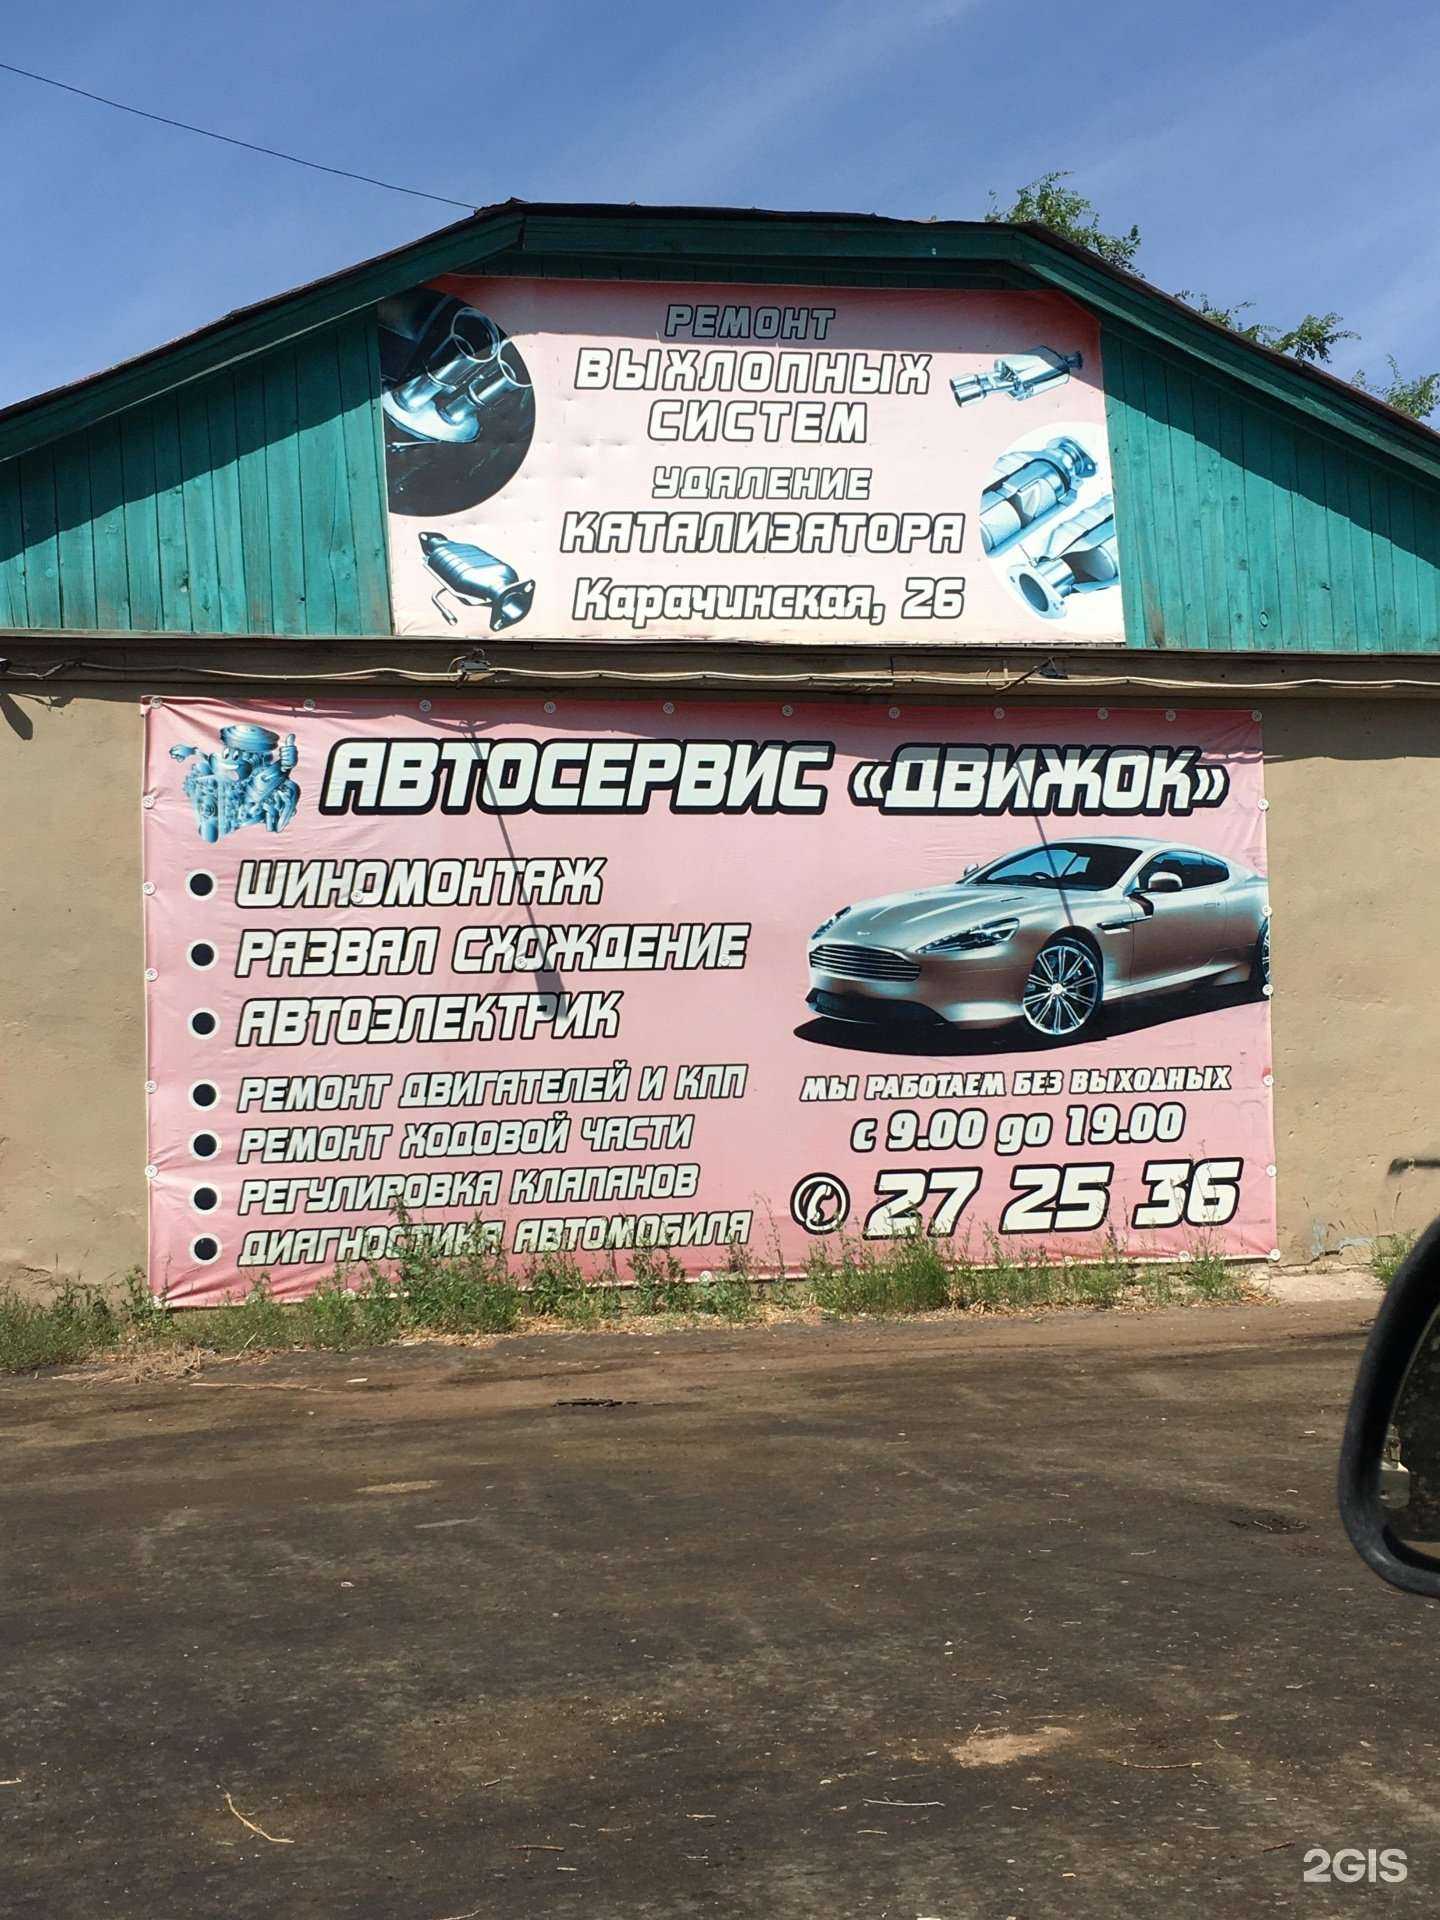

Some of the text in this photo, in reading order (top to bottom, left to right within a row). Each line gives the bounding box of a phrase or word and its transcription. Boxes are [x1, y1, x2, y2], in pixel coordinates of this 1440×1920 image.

[665, 304, 835, 339] РЕМОНТ
[573, 347, 932, 395] ВЫХЛОПНЫХ
[647, 400, 869, 443] СИСТЕМ
[652, 466, 871, 501] УДАЛЕНИЕ
[560, 512, 966, 555] КАТАЛИЗАТОРА
[572, 577, 966, 629] Карачинская, 26
[318, 737, 1230, 816] АВТОСЕРВИС «ДВИЖОК»
[235, 857, 607, 908] ШИНОМОНТАЖ
[235, 922, 751, 977] РАЗВАЛ СХОЖДЕНИЕ
[235, 991, 624, 1047] АВТОЭЛЕКТРИК
[236, 1060, 749, 1113] РЕМОНТ ДВИГАТЕЛЕЙ И КПП
[799, 1066, 1231, 1101] МЫ РАБОТАЕМ БЕЗ ВЫХОДНЫХ
[237, 1111, 695, 1164] РЕМОНТ ХОДОВОЙ ЧАСТИ
[850, 1102, 1186, 1155] с 9.00 до 19.00
[237, 1163, 700, 1215] РЕГУЛИРОВКА КЛАПАНОВ
[862, 1156, 1244, 1241] 27 25 36
[237, 1210, 753, 1267] ДИАГНОСТИКА АВТОМОБИЛЯ
